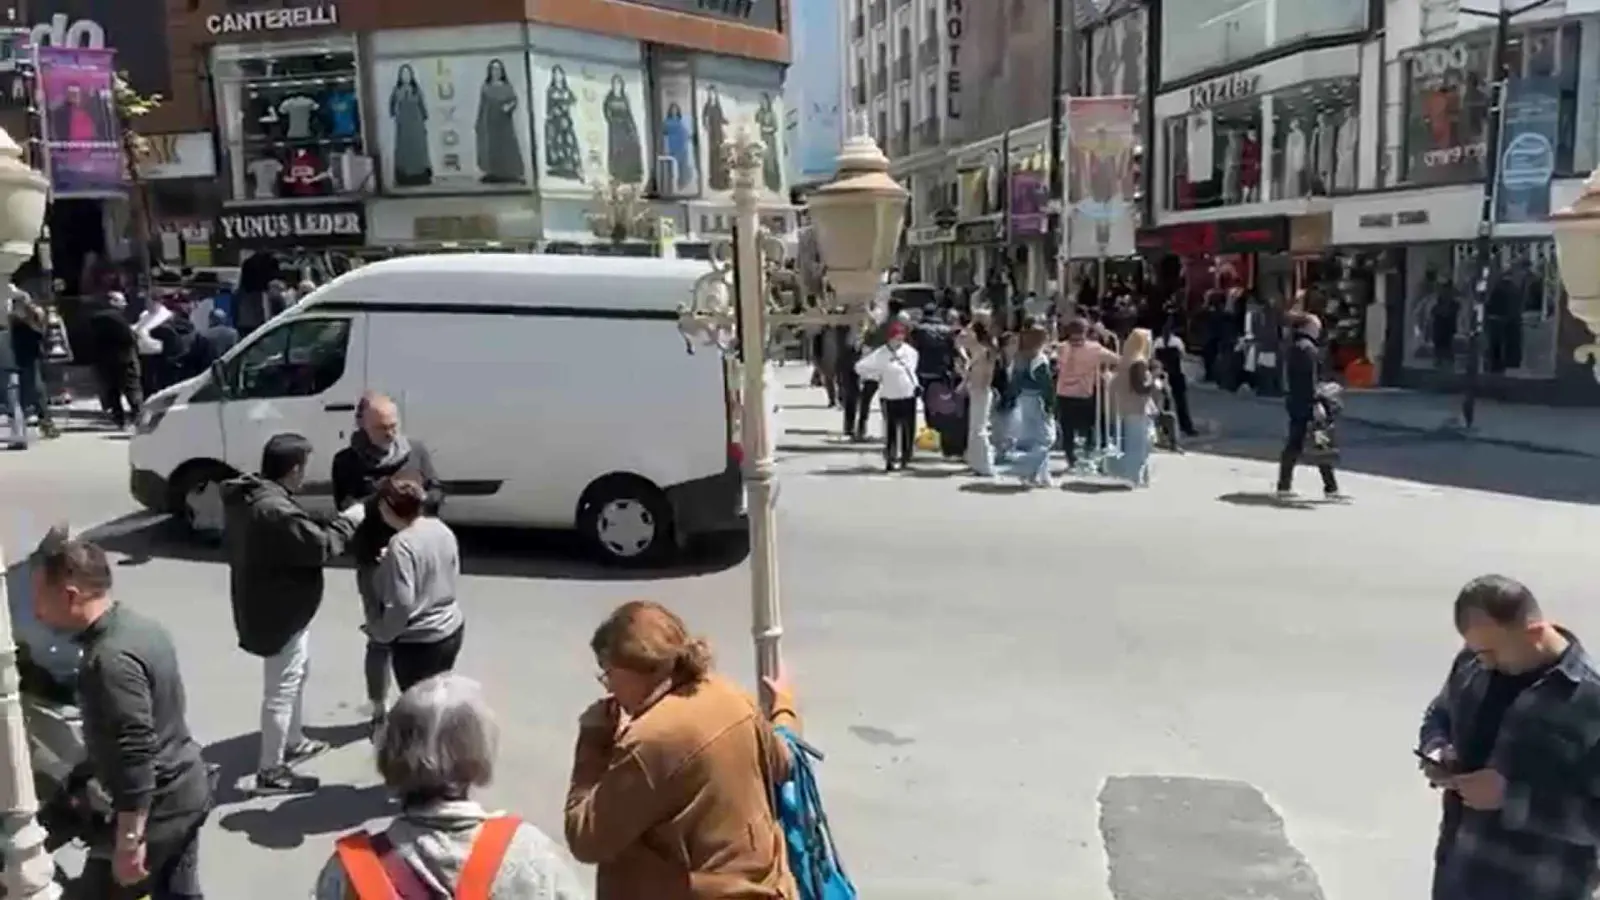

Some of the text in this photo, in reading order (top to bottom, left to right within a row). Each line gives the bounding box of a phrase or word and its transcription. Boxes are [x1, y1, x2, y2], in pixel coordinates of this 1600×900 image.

[206, 4, 337, 34] CANTERELLI
[221, 212, 361, 238] YUNUS LEDER
